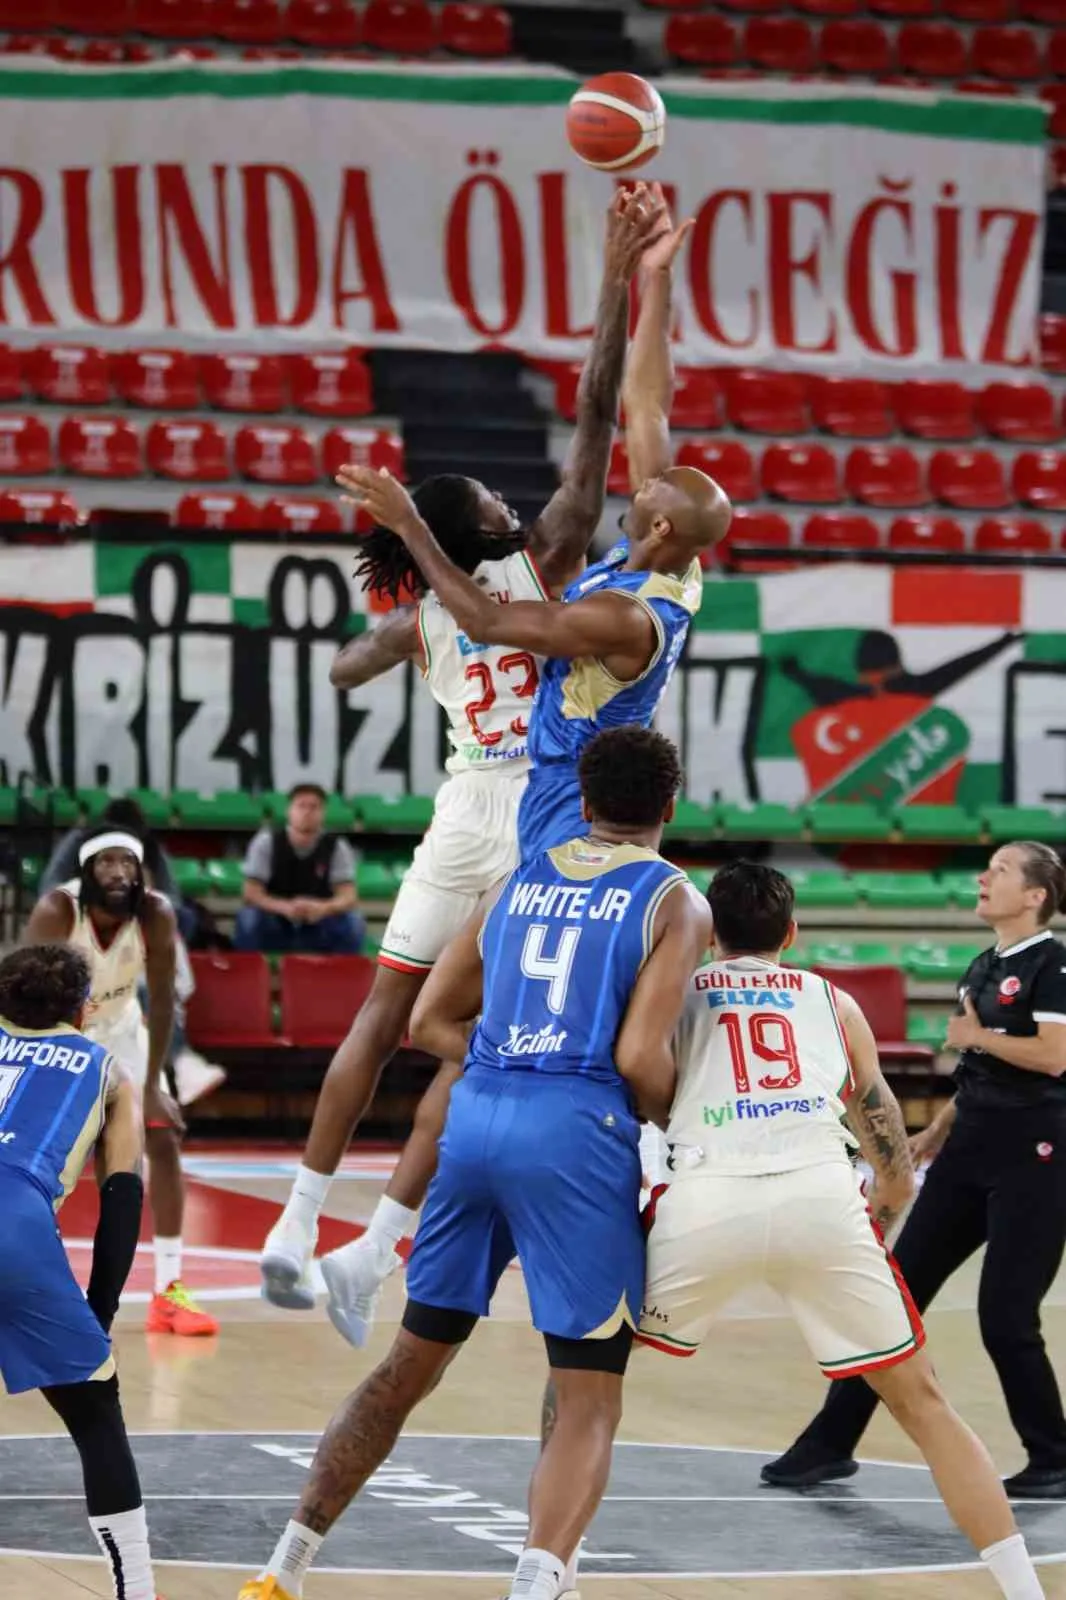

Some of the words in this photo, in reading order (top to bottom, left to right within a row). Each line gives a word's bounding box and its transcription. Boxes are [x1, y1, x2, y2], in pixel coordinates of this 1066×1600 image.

[466, 653, 539, 746] 23
[508, 882, 592, 918] WHITE
[588, 887, 632, 923] JR
[520, 923, 583, 1016] 4
[718, 1012, 802, 1094] 19
